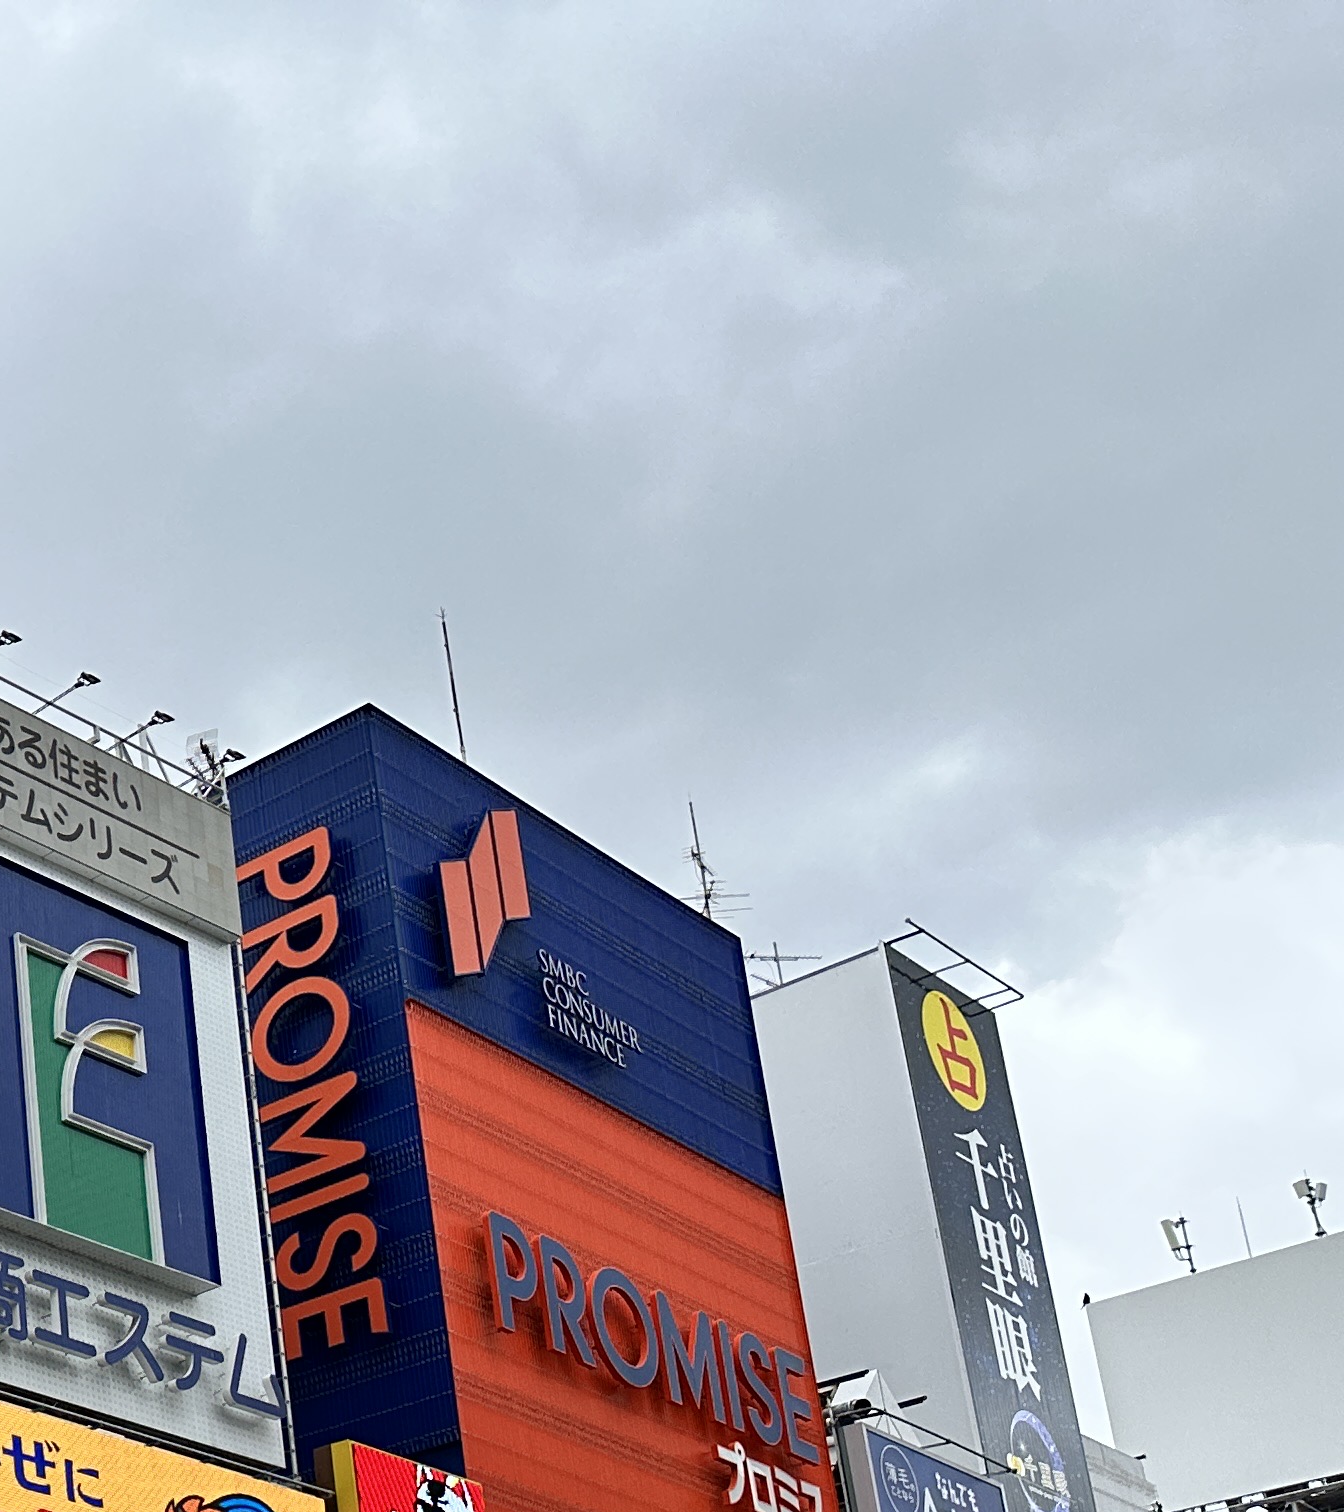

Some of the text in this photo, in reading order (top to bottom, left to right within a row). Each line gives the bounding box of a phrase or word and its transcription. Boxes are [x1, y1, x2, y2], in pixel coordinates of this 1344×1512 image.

[536, 948, 590, 997] SMBC
[541, 976, 644, 1054] CONSUMER
[235, 825, 391, 1361] PROMISE
[547, 1003, 629, 1070] FINANCE
[936, 996, 980, 1101] 占
[953, 1127, 1042, 1404] 千里眼
[997, 1142, 1039, 1288] 占いの館
[484, 1210, 821, 1466] PROMISE
